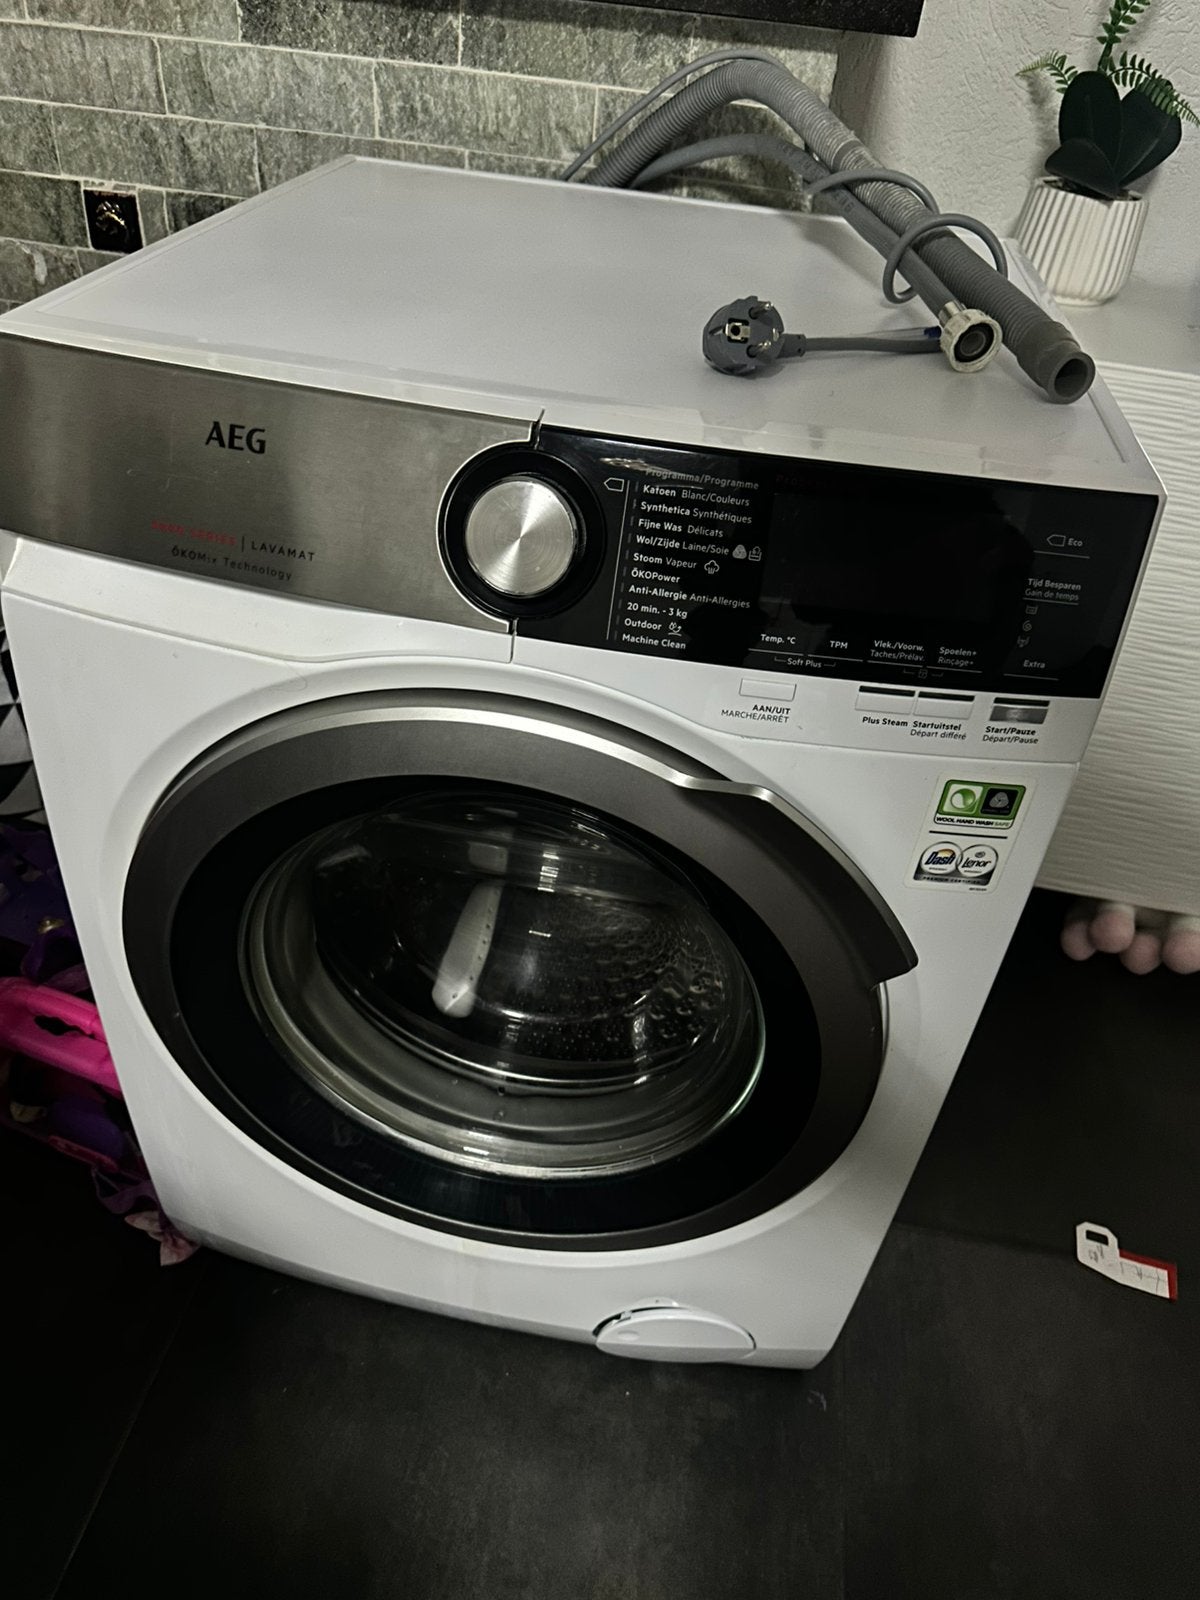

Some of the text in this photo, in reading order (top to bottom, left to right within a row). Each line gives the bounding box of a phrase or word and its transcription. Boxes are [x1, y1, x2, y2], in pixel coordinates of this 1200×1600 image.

[205, 421, 266, 454] AEG
[646, 469, 759, 490] Programma/Programme
[643, 484, 750, 507] Katoen Blanc/Couleurs
[640, 501, 752, 524] Synthetica Synthétiques
[638, 518, 724, 538] Fijne Was Délicats
[636, 535, 730, 556] Wol/Zijde Laine/Soie
[1068, 538, 1083, 547] Eco
[251, 541, 315, 561] LAVAMAT
[171, 545, 292, 582] ÖKOMix Technology
[633, 553, 697, 569] Stoom Vapeur
[631, 567, 680, 584] ÖKOPower
[1028, 578, 1082, 591] Tijd Besparen
[629, 585, 751, 609] Anti-Allergie Anti-Allergies
[1025, 588, 1080, 602] Gain de temps
[627, 602, 639, 611] 20
[640, 604, 660, 614] min.
[668, 607, 674, 616] 3
[675, 608, 688, 619] kg
[624, 618, 662, 631] Outdoor
[622, 633, 686, 650] Machine Clean
[760, 633, 796, 645] Temp. °C
[830, 640, 848, 649] TPM
[874, 640, 925, 652] Vlek./Voorw.
[787, 657, 822, 668] Soft Plus
[1023, 659, 1046, 669] Extra
[721, 709, 789, 723] MARCHE/ARRÊT
[752, 704, 791, 715] AAN/UIT
[862, 716, 908, 728] Plus Steam
[913, 720, 962, 731] Startuitstel
[910, 728, 967, 741] Départ différé
[985, 726, 1036, 736] Start/Pauze
[982, 734, 1039, 745] Départ/Pause
[924, 850, 956, 865] Dash
[961, 857, 992, 869] Lenor
